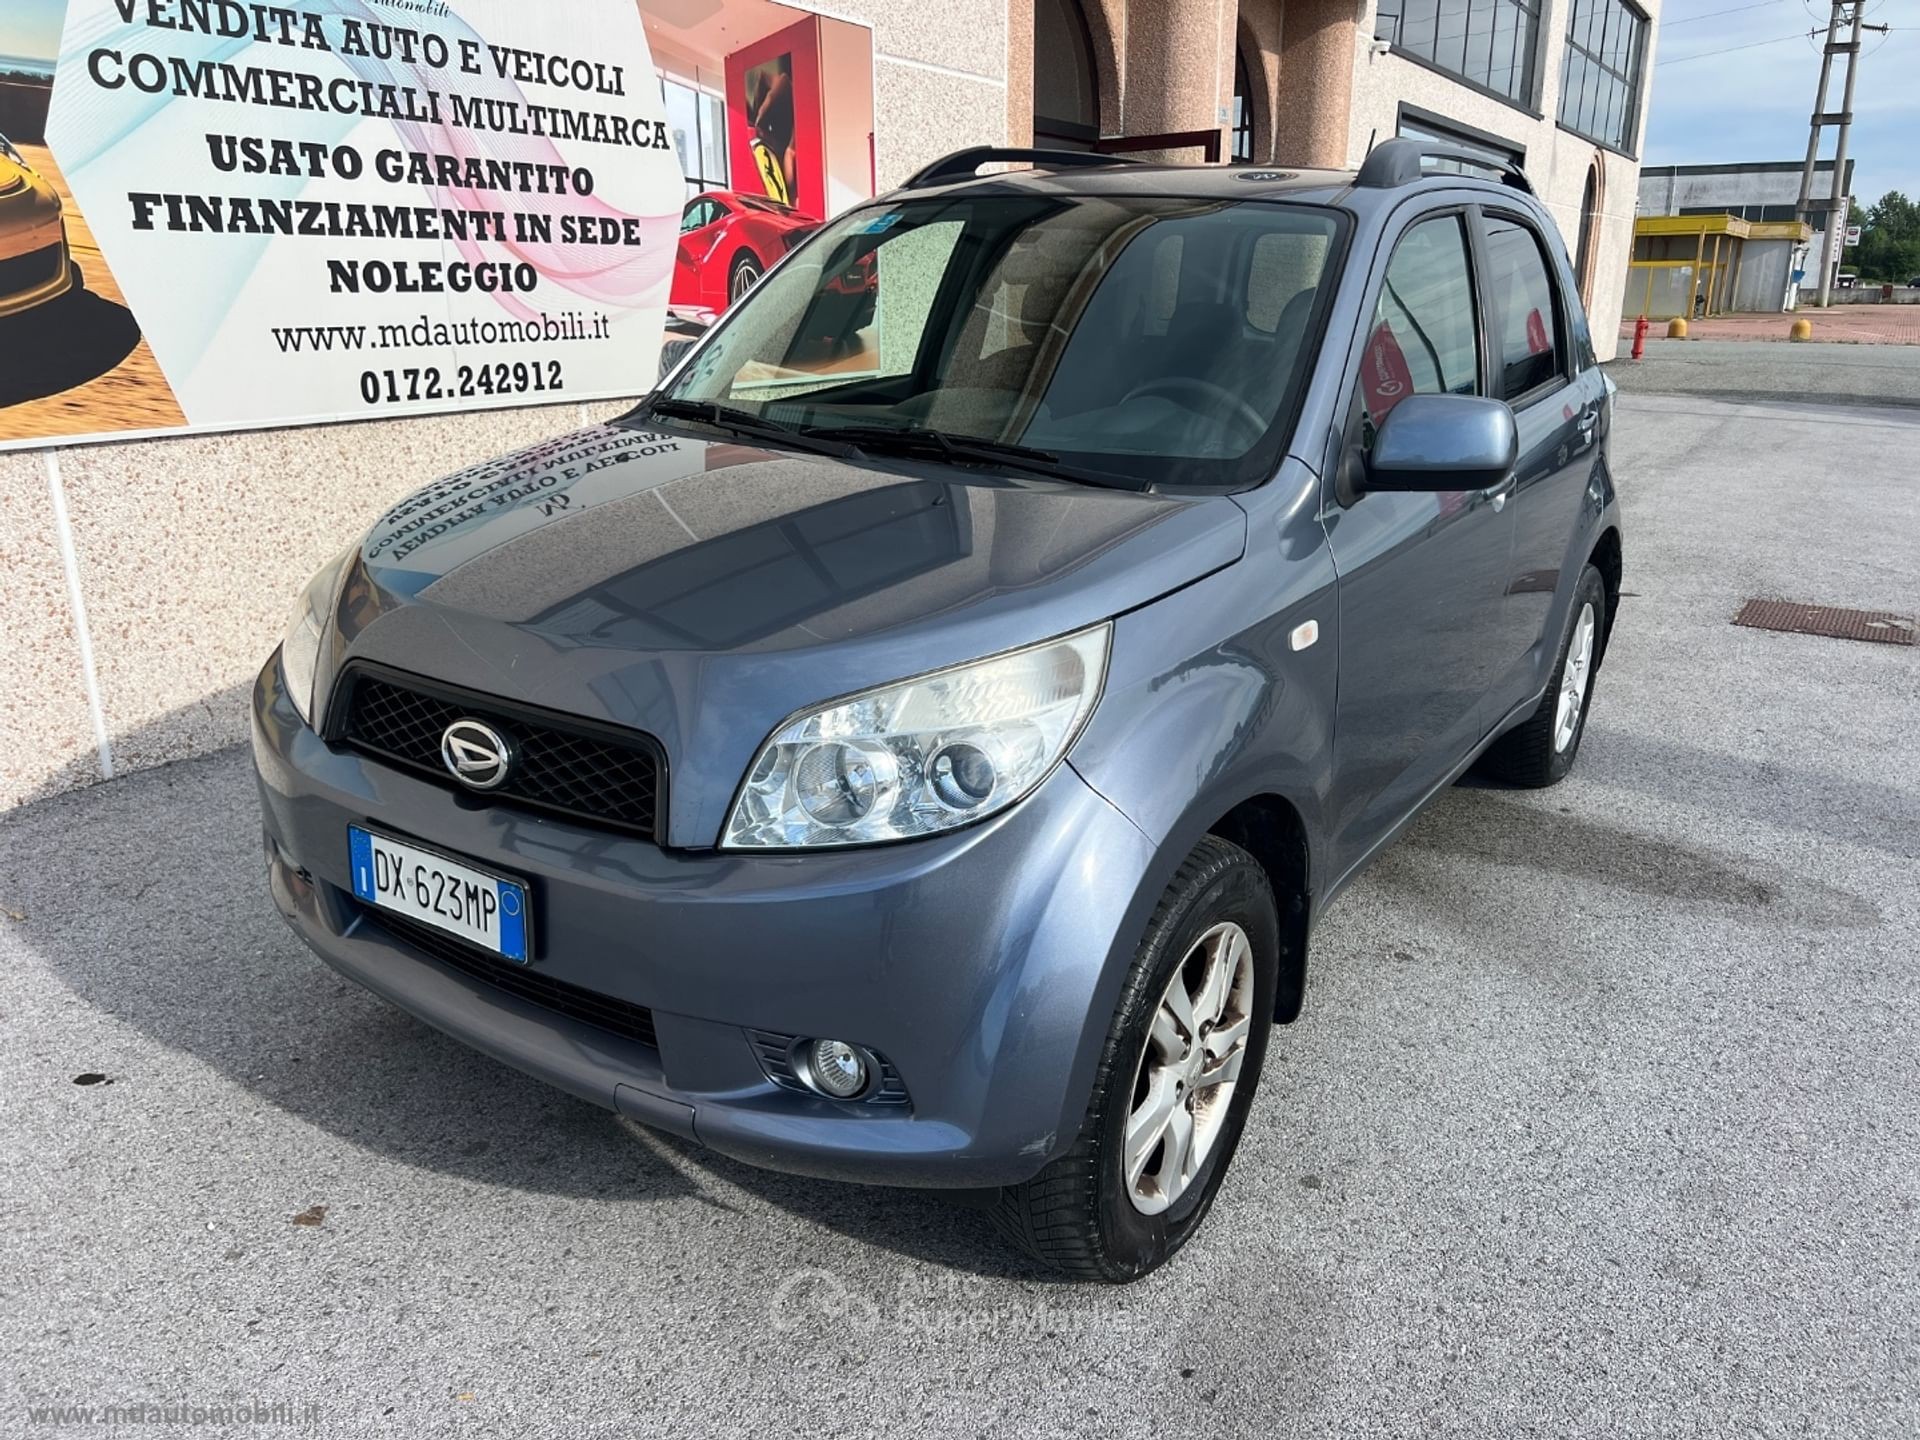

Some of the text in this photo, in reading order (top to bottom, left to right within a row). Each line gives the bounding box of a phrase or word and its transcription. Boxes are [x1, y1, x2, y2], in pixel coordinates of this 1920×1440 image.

[371, 0, 450, 18] utomobili
[112, 0, 625, 96] VENDITA AUTO E VEICOLI
[87, 48, 670, 150] COMMERCIALI MULTIMARCA
[205, 134, 594, 196] USATO GARANTITO
[127, 192, 641, 246] FINANZIAMENTI IN SEDE
[327, 260, 538, 293] NOLEGGIO
[272, 311, 610, 352] www.mdautomobili.it
[360, 360, 563, 404] 0172.242912
[375, 848, 497, 933] DX 623MP
